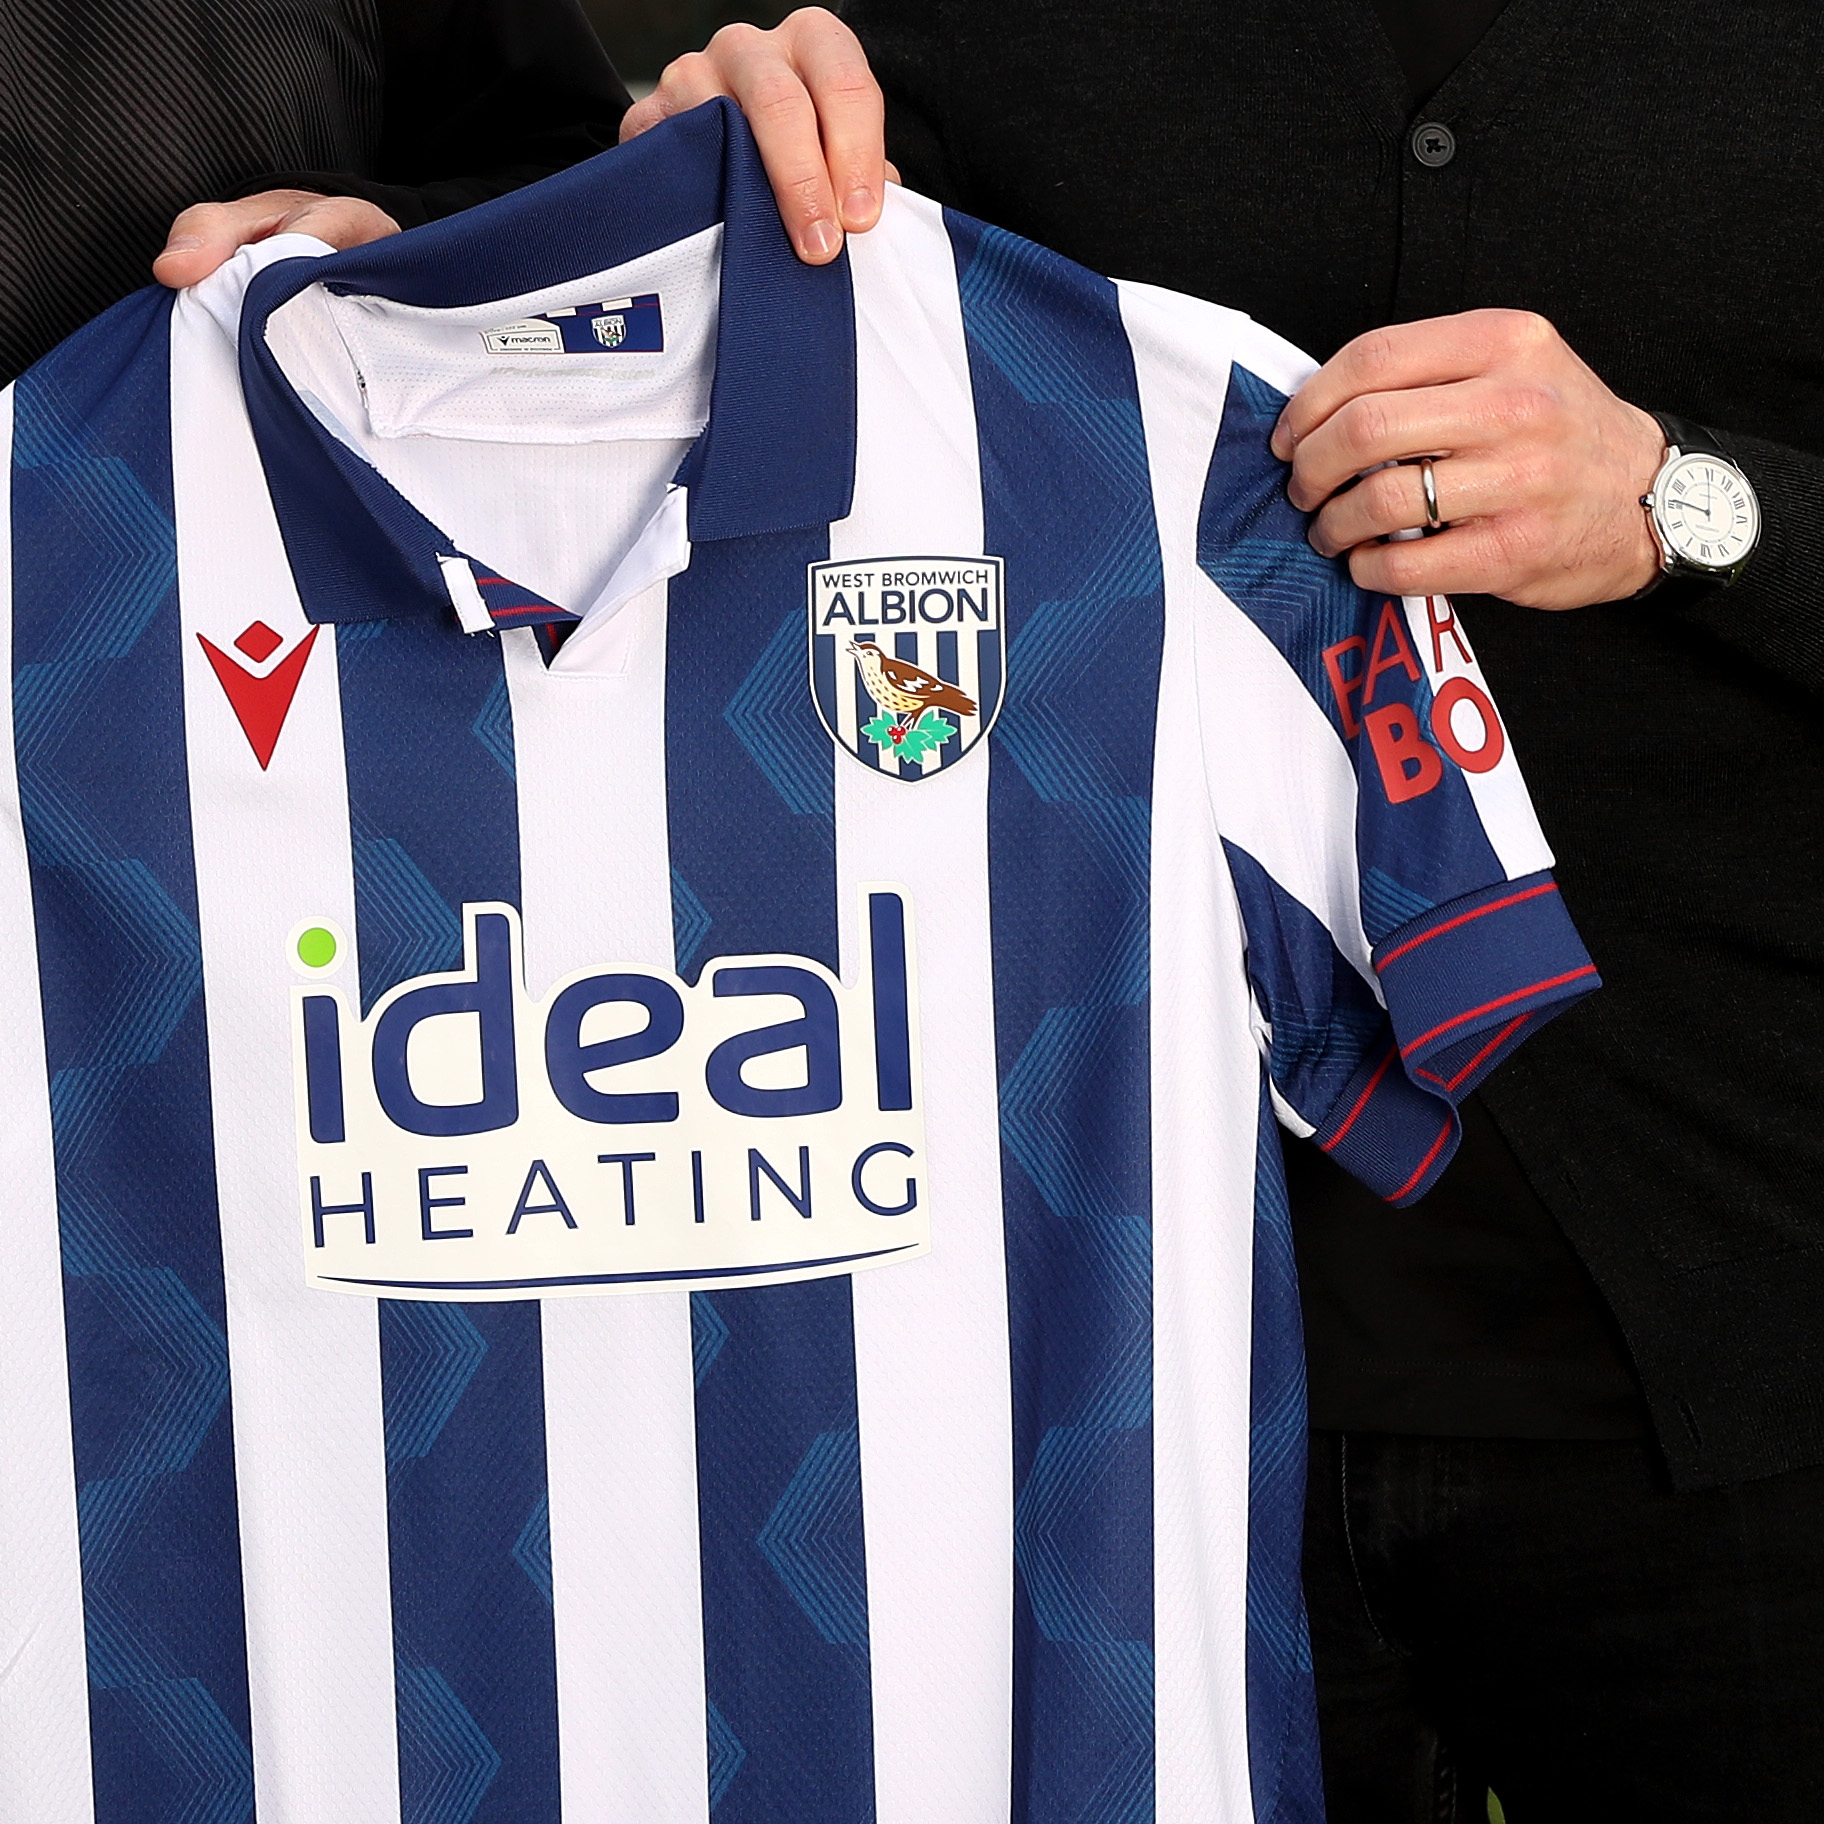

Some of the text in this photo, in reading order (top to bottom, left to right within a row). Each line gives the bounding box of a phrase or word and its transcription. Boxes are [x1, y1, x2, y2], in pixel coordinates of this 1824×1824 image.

[511, 336, 551, 344] macron
[822, 569, 988, 588] WEST BROMWICH
[822, 587, 989, 626] ALBION
[298, 892, 913, 1144] ideal
[309, 1141, 918, 1248] HEATING
